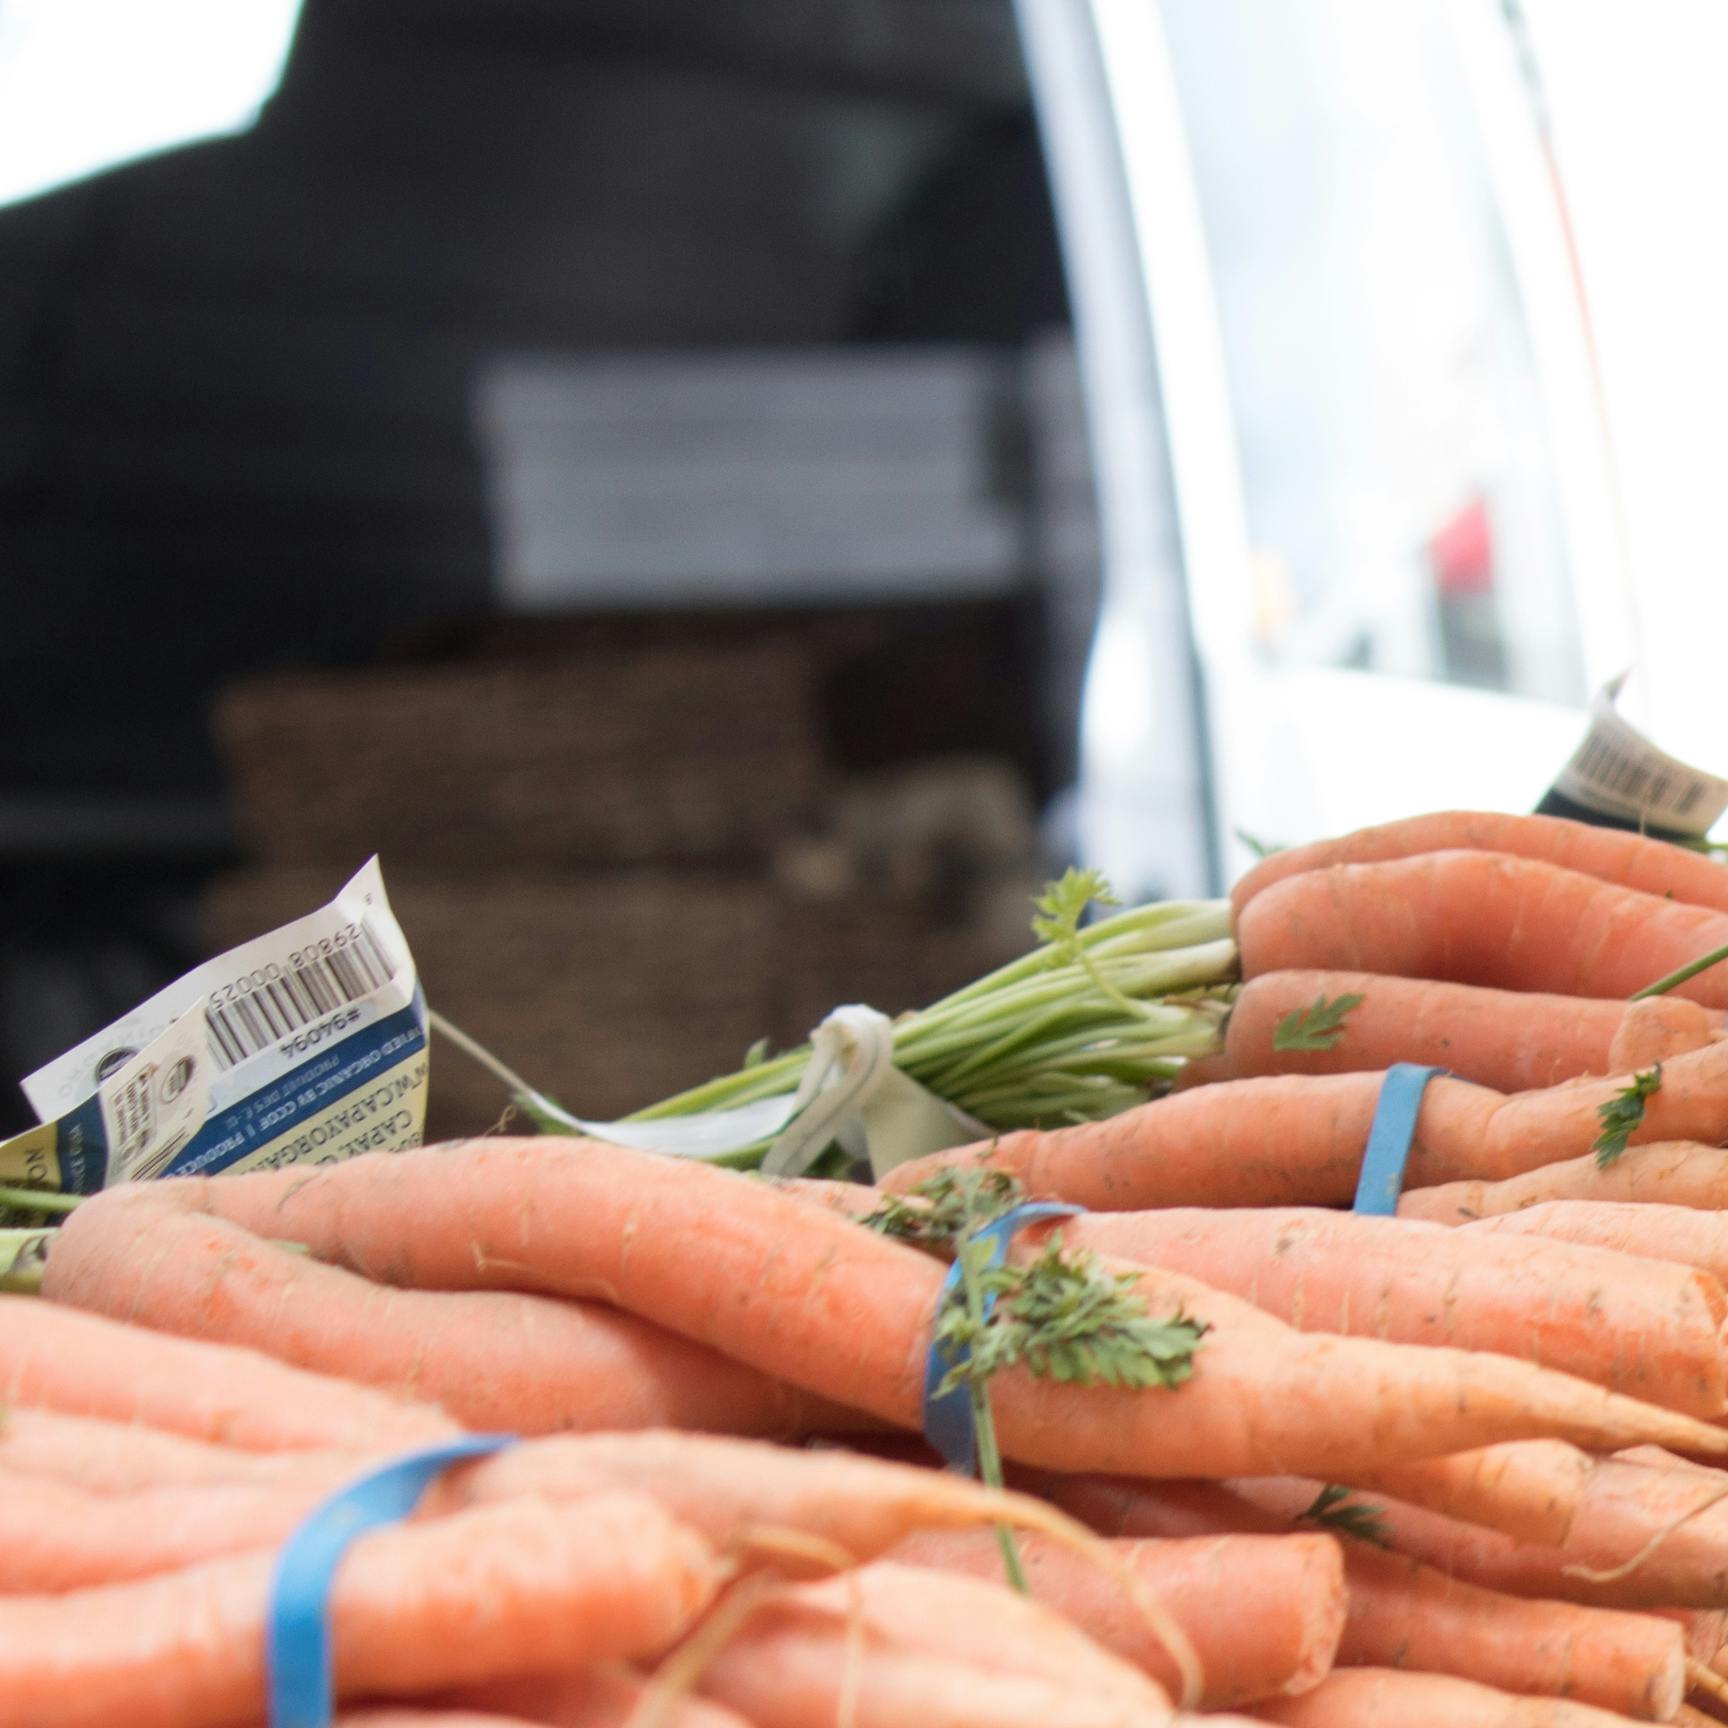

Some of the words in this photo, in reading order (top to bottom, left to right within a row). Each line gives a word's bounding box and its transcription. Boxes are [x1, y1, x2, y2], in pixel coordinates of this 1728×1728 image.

[288, 922, 361, 969] 29808
[208, 961, 282, 1011] 00025
[280, 1006, 361, 1059] #94094
[315, 1049, 382, 1096] ORGANIC
[258, 1100, 298, 1132] CCOF
[297, 1087, 318, 1107] BY
